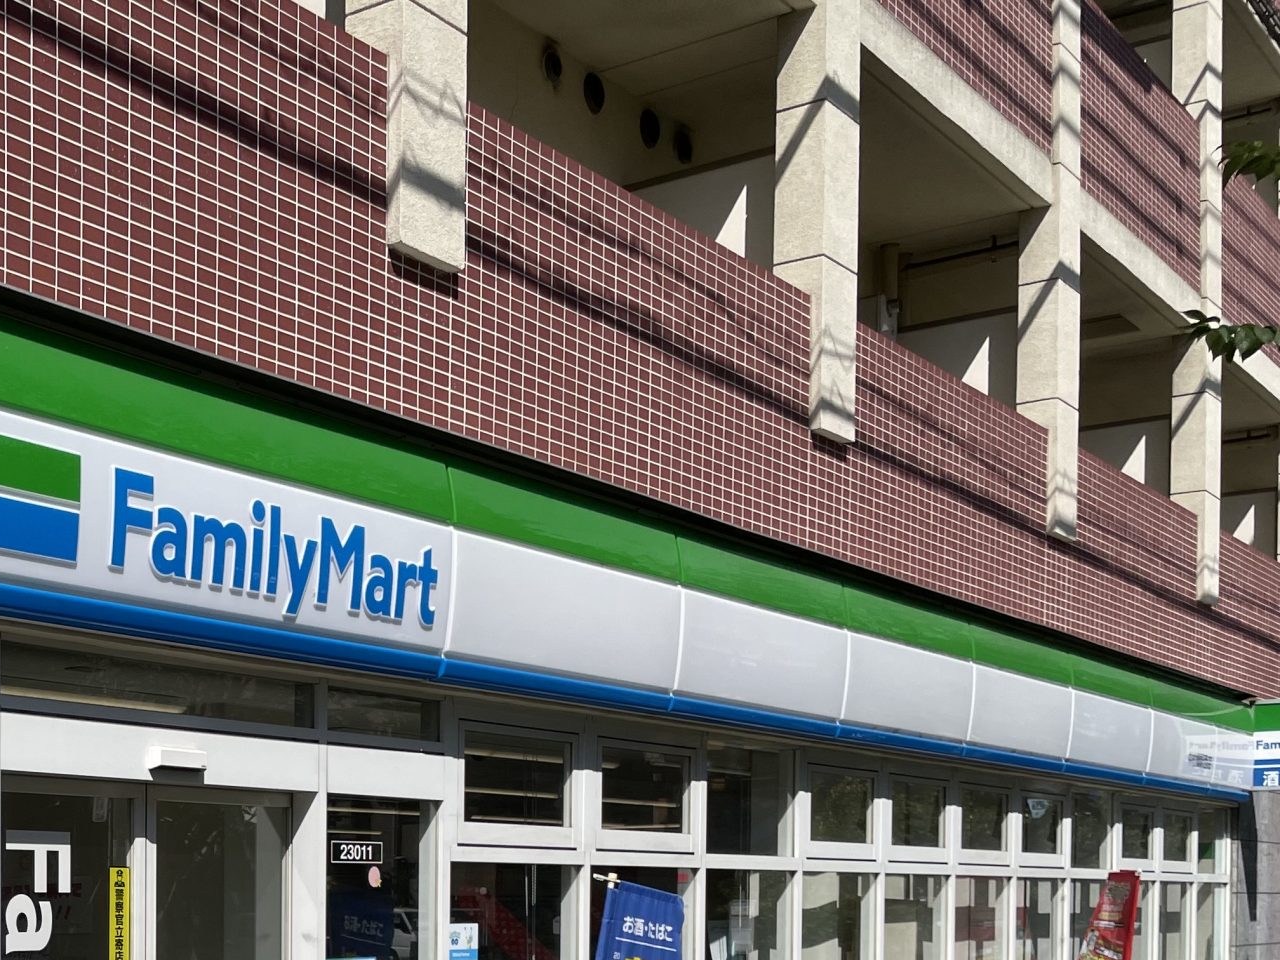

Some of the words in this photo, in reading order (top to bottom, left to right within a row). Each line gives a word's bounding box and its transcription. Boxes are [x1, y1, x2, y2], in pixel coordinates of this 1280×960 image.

[111, 466, 439, 628] FamilyMart
[340, 844, 373, 861] 23011
[623, 915, 673, 942] お酒・たばこ
